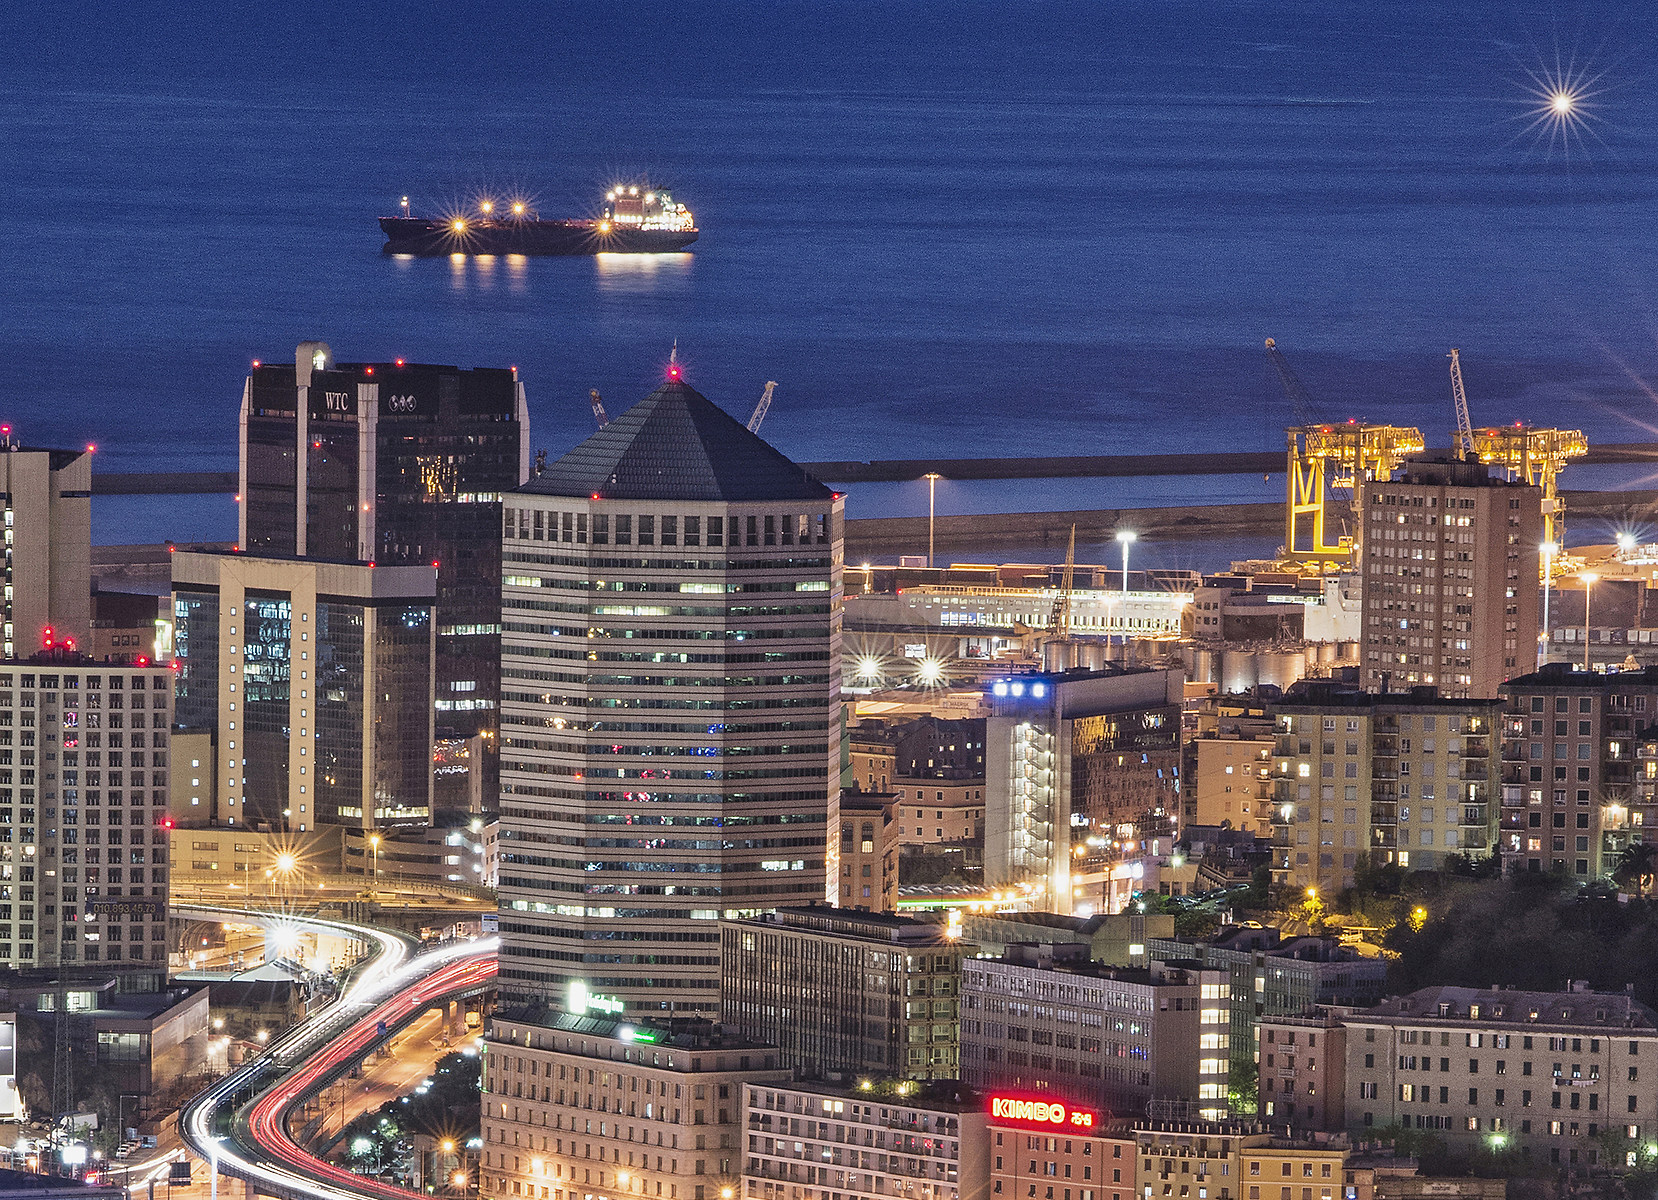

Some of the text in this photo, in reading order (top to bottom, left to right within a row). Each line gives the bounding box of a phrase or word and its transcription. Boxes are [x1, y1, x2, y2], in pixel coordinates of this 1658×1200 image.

[325, 392, 349, 411] WTC
[93, 903, 157, 914] 010.893.45.73
[992, 1098, 1066, 1124] KIMBO
